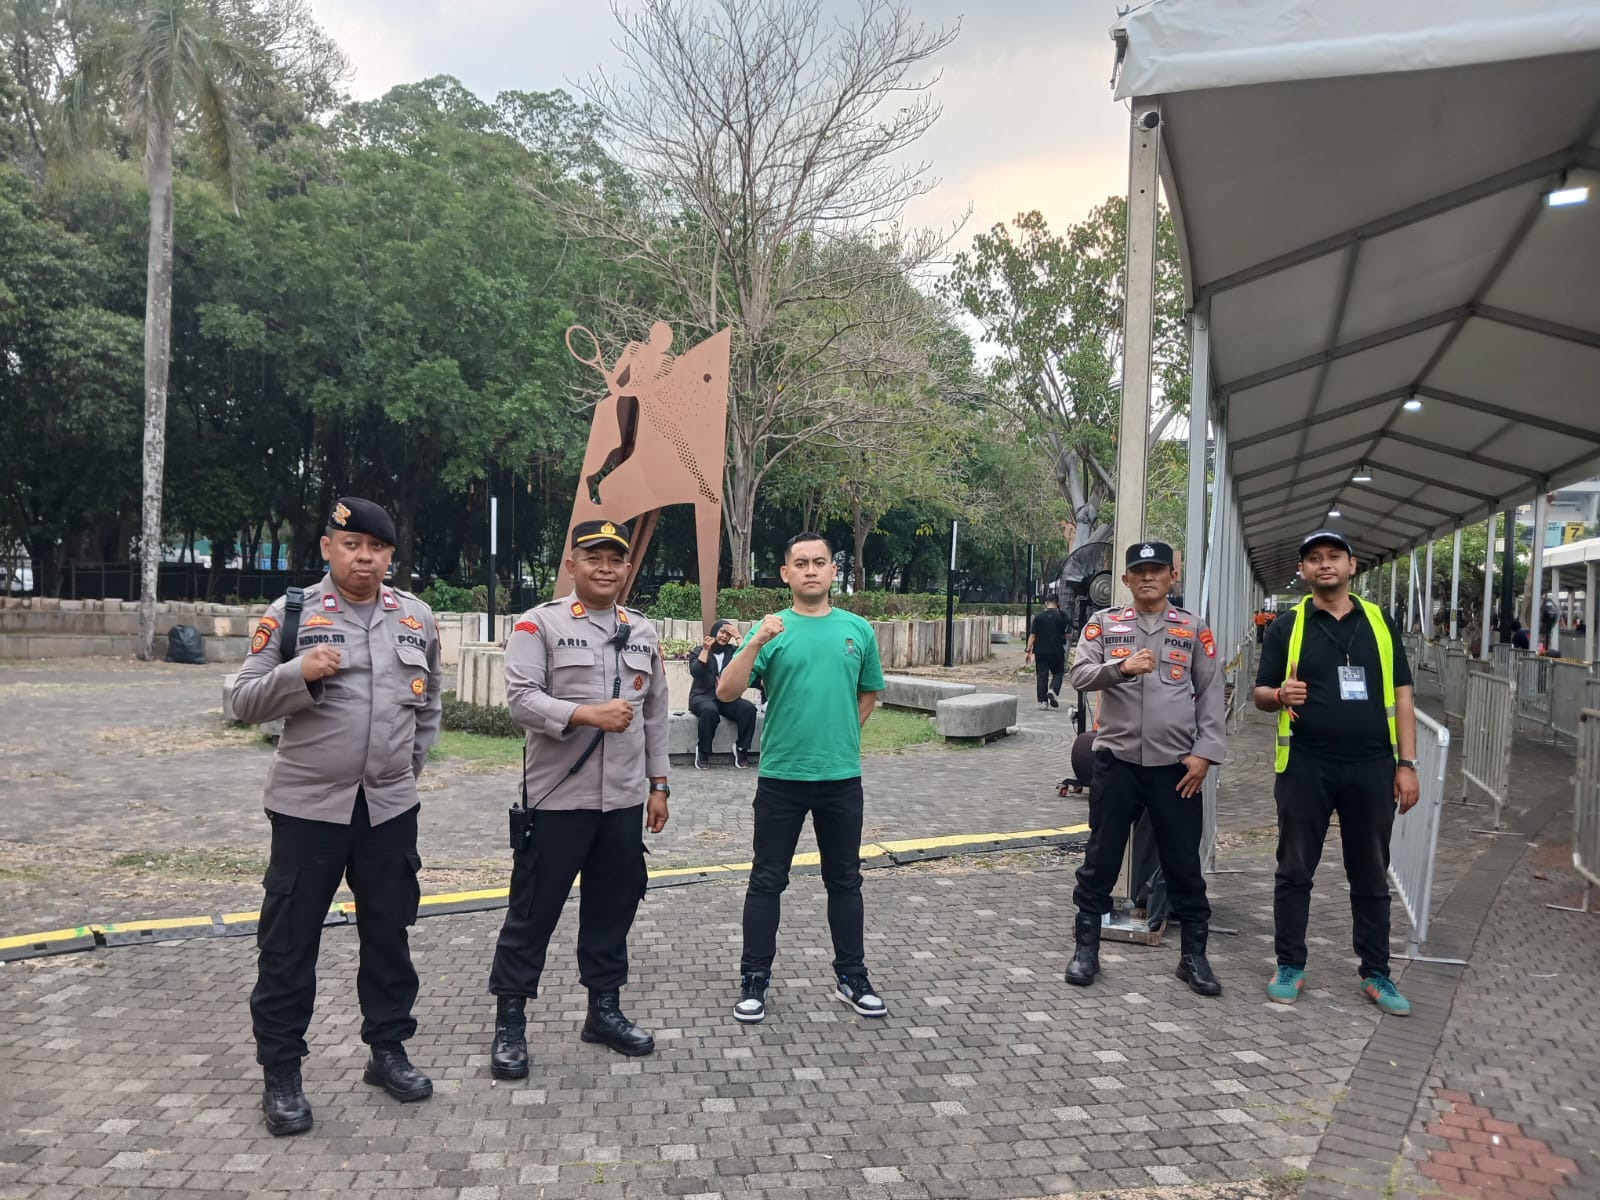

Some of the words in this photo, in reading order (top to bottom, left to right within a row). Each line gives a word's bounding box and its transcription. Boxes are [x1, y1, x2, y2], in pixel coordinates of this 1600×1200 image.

[1570, 527, 1580, 538] 7
[557, 638, 588, 647] ARIS
[1164, 638, 1192, 650] POLRI
[624, 644, 651, 654] POLRI
